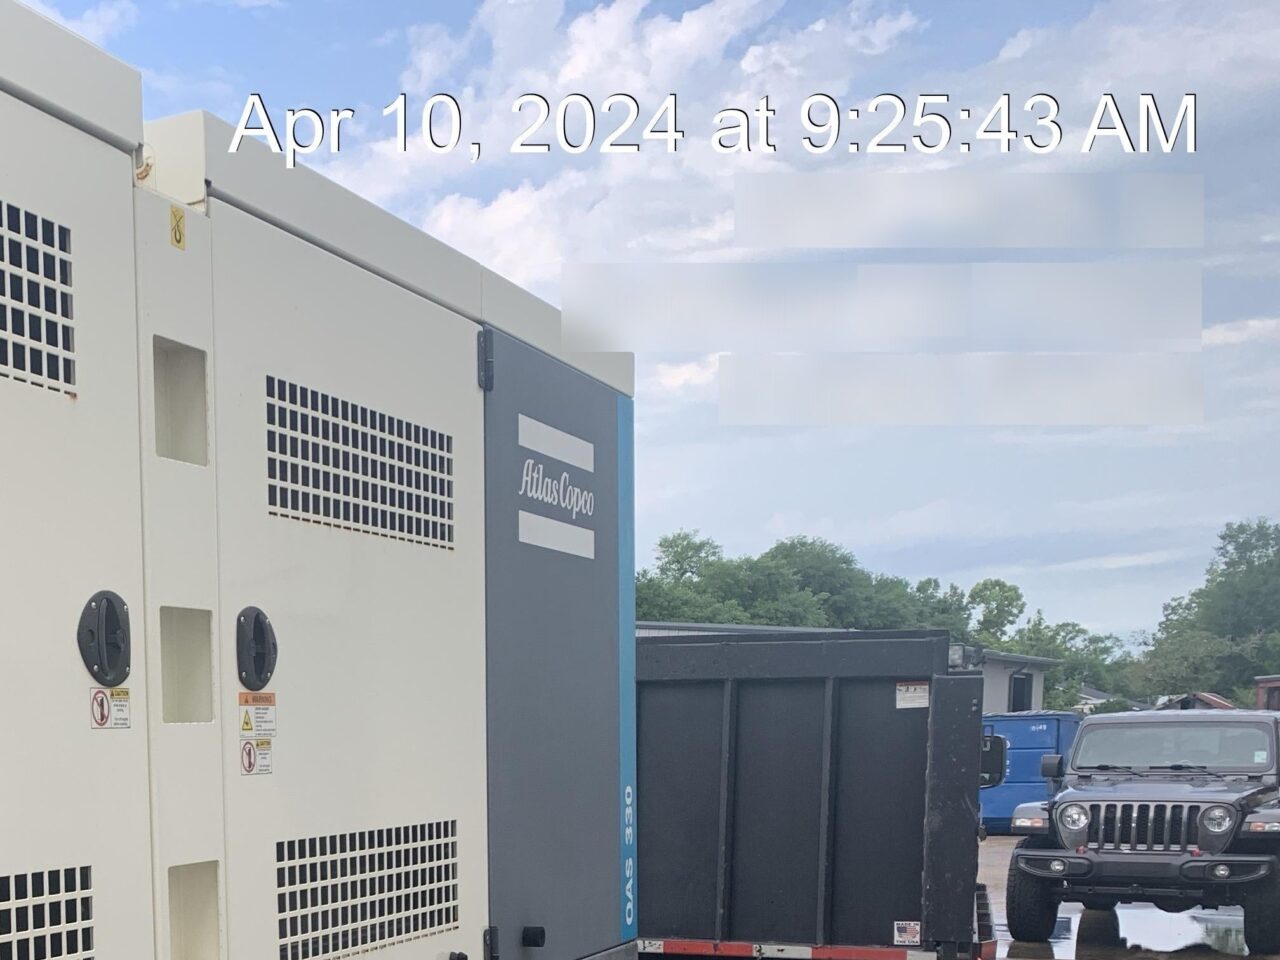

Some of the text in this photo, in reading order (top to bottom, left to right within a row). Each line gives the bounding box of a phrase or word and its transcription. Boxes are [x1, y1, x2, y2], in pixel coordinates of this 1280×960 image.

[519, 459, 594, 519] Atlas Copco
[624, 785, 634, 926] QAS 330
